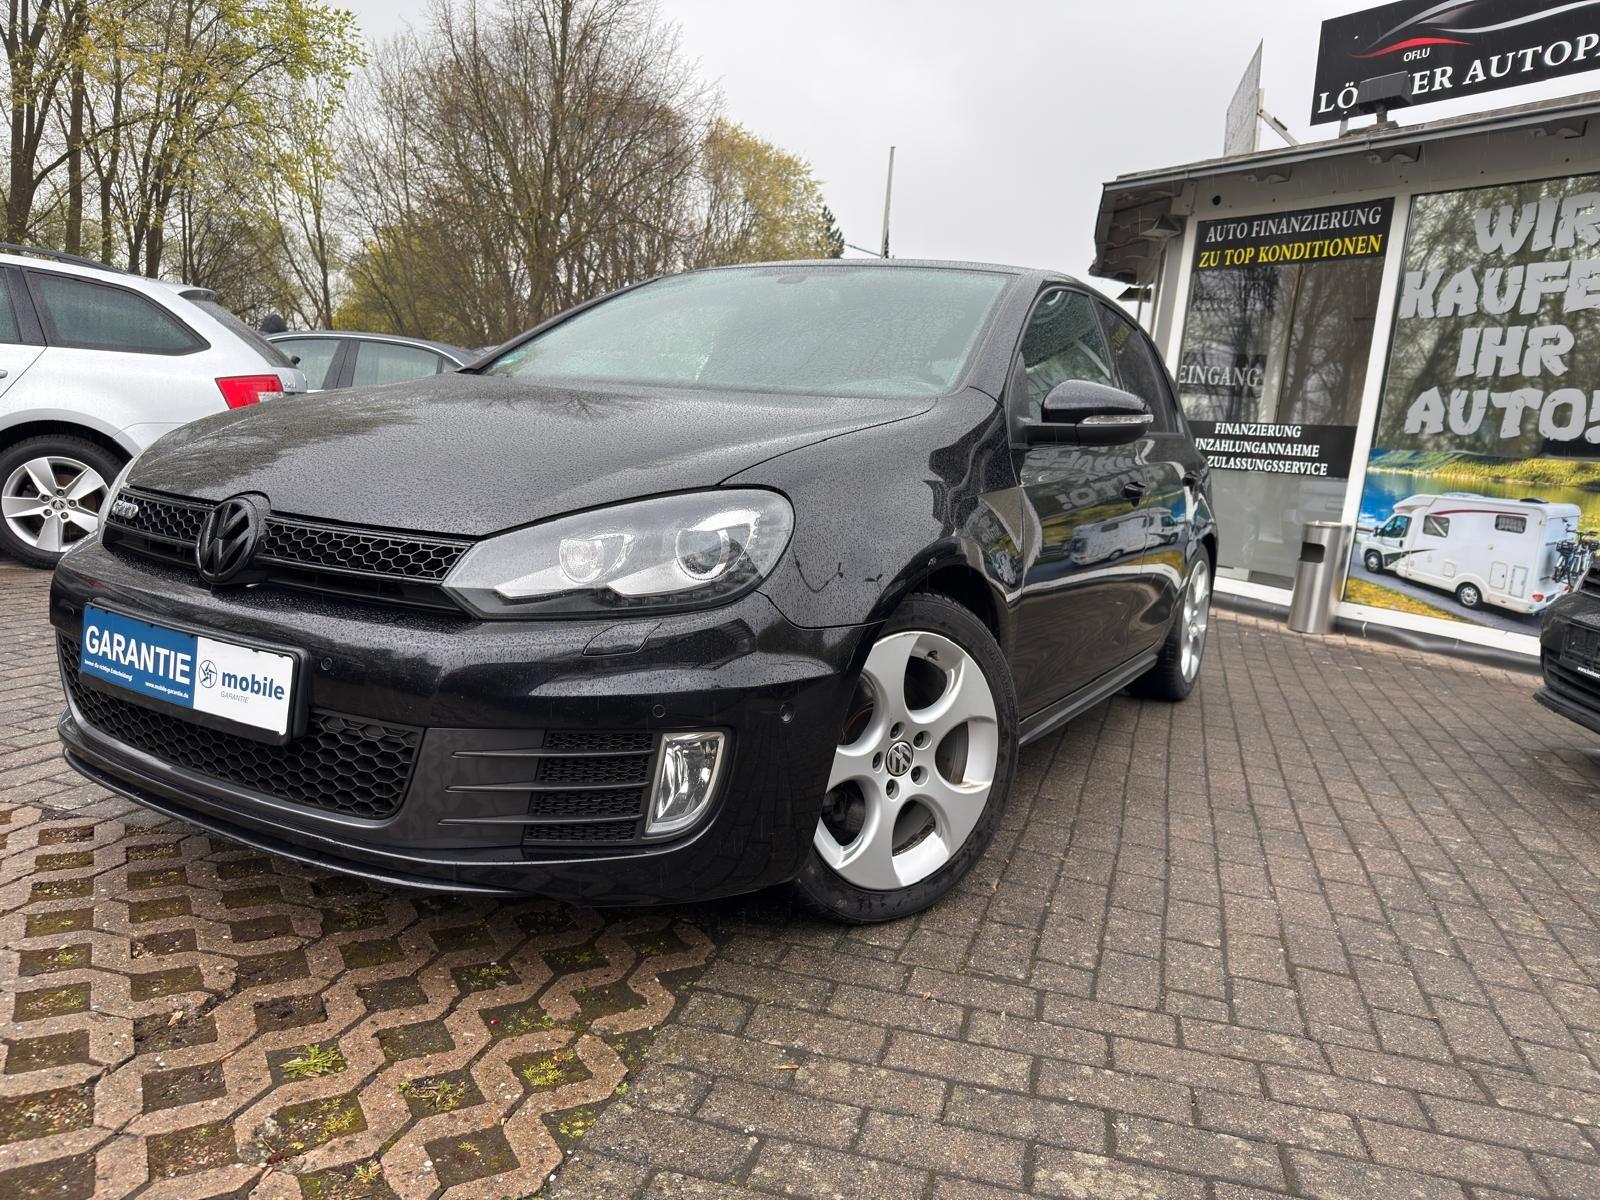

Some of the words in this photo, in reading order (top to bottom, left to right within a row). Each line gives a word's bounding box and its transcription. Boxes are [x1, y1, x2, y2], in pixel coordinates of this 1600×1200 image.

[1403, 47, 1430, 62] OFLU
[1317, 65, 1453, 113] LÖER
[1462, 33, 1600, 85] AUTOP
[1205, 222, 1247, 243] AUTO
[1251, 206, 1382, 238] FINANZIERUNG
[1474, 192, 1600, 255] WIR
[1199, 250, 1221, 268] ZU
[1225, 247, 1255, 266] TOP
[1258, 234, 1383, 263] KONDITIONEN
[1455, 324, 1575, 378] IHR
[1178, 364, 1260, 388] EINGANG
[1214, 422, 1302, 438] FINANZIERUNG
[1404, 386, 1600, 444] AUTO!
[1195, 437, 1321, 458] INZAHLUNGANNAHME
[1207, 455, 1328, 476] ZULASSUNGSSERVICE
[85, 625, 192, 685] GARANTIE
[220, 690, 249, 704] GARANTIE
[221, 671, 285, 701] mobile
